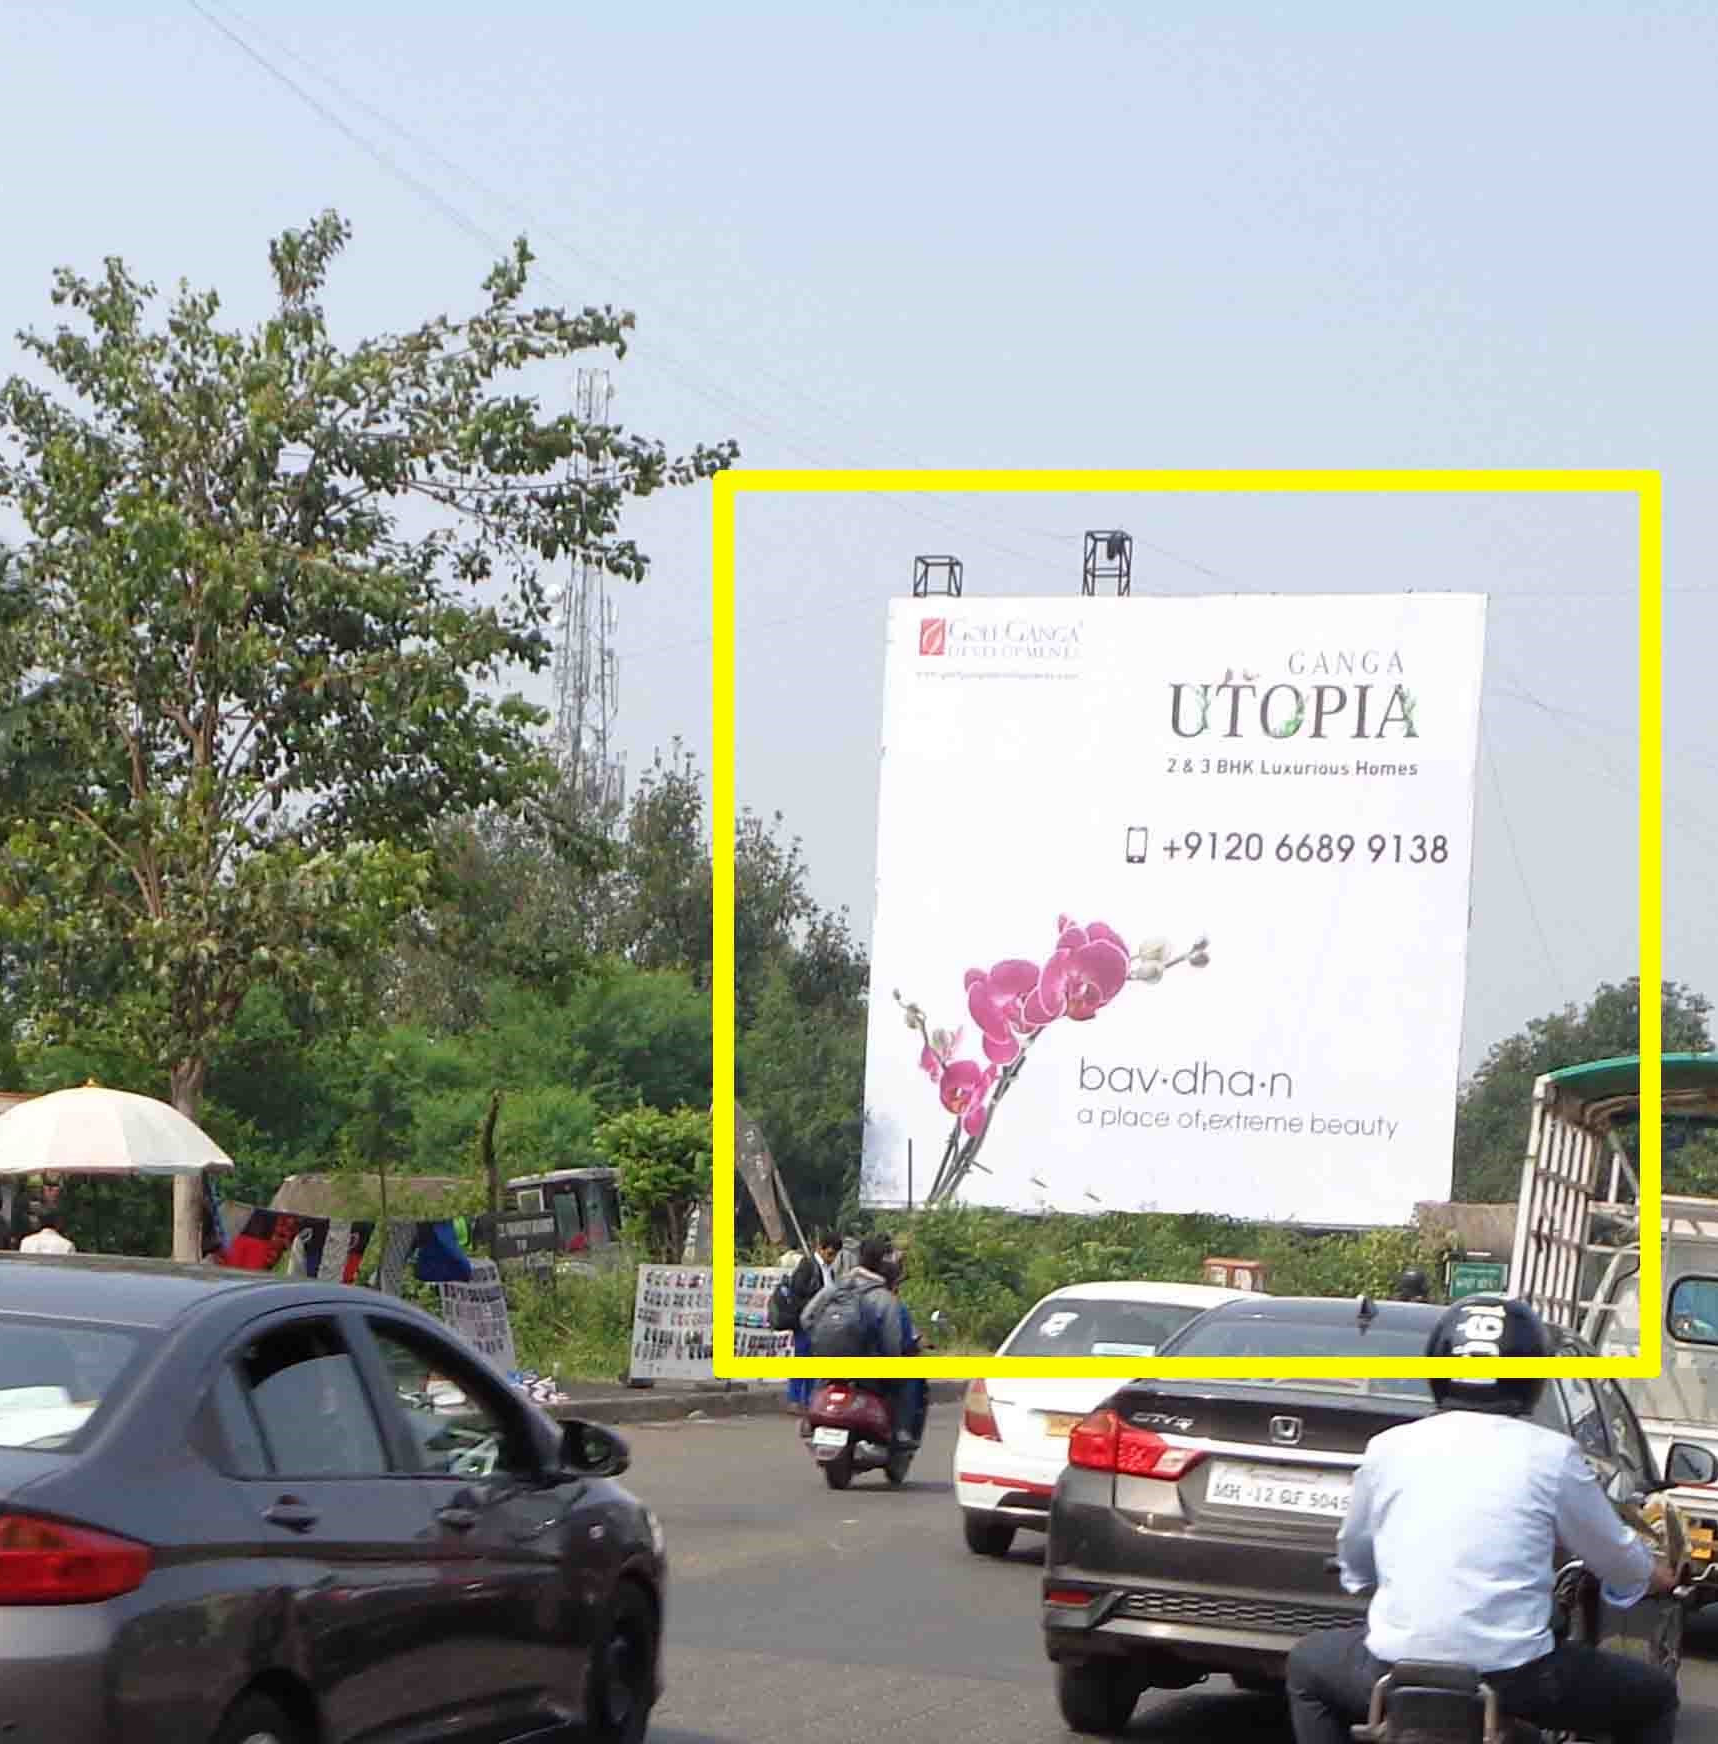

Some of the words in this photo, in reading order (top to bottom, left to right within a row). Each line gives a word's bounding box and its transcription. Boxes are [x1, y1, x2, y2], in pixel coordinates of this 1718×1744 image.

[1288, 649, 1404, 675] GANGA
[1169, 682, 1420, 739] UTOPIA
[1166, 758, 1177, 774] 2
[1182, 758, 1194, 774] &
[1200, 758, 1211, 774] 3
[1216, 759, 1255, 775] BHK
[1260, 759, 1350, 776] Luxurious
[1355, 760, 1419, 777] Homes
[1162, 831, 1264, 862] +9120
[1275, 833, 1355, 863] 6689
[1367, 834, 1449, 864] 9138
[1077, 1108, 1093, 1125] a
[1100, 1106, 1170, 1128] place
[1177, 1108, 1202, 1130] of
[1208, 1110, 1303, 1134] extreme
[1310, 1111, 1399, 1142] beauty
[1213, 1482, 1242, 1502] MH
